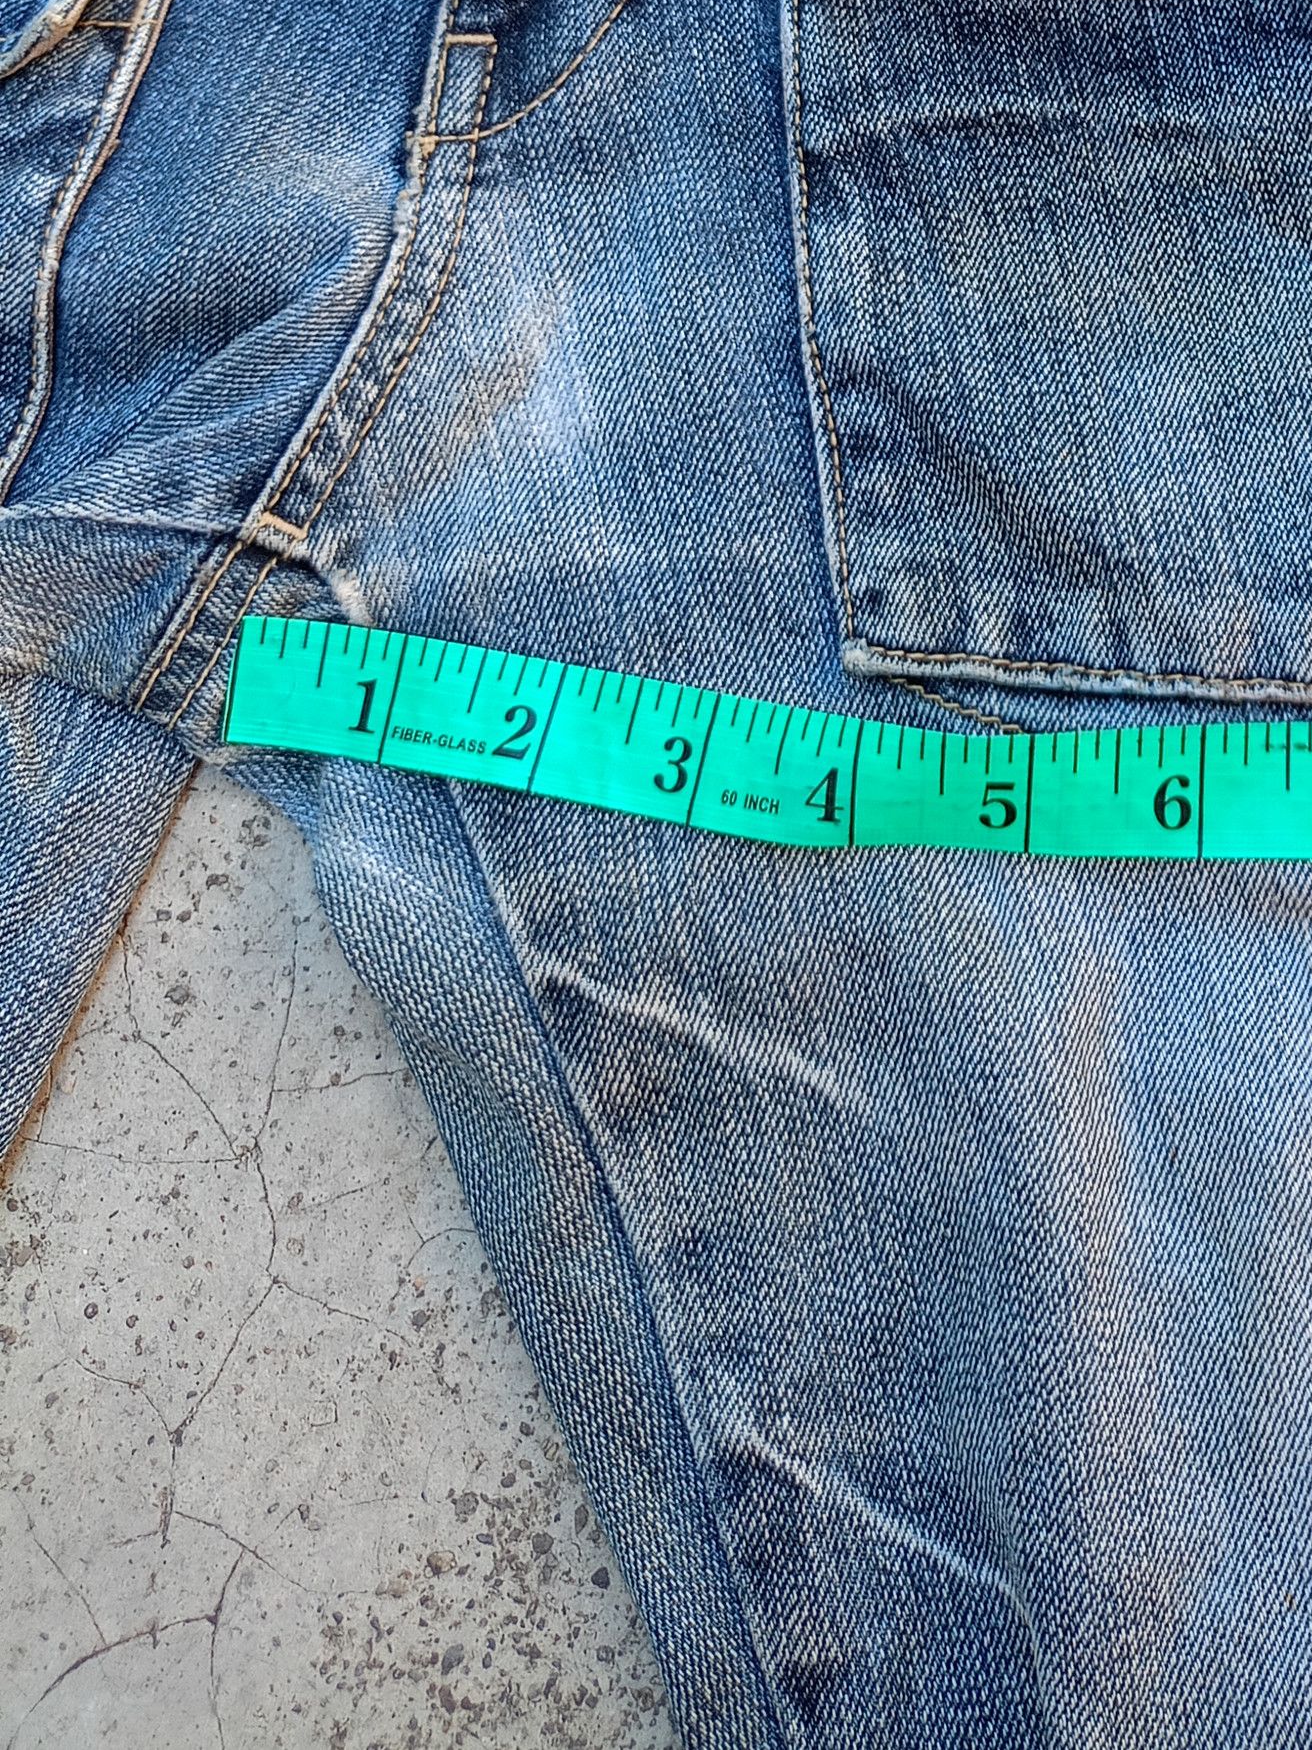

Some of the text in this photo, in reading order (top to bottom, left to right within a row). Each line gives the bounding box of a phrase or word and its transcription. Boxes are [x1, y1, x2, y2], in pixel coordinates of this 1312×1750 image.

[348, 679, 374, 734] 1
[492, 704, 537, 759] 2
[653, 737, 692, 793] 3
[804, 767, 845, 824] 4
[978, 782, 1017, 829] 5
[1153, 775, 1192, 830] 6
[391, 725, 488, 755] FIBER-GLASS
[721, 789, 780, 815] 60 INCH
